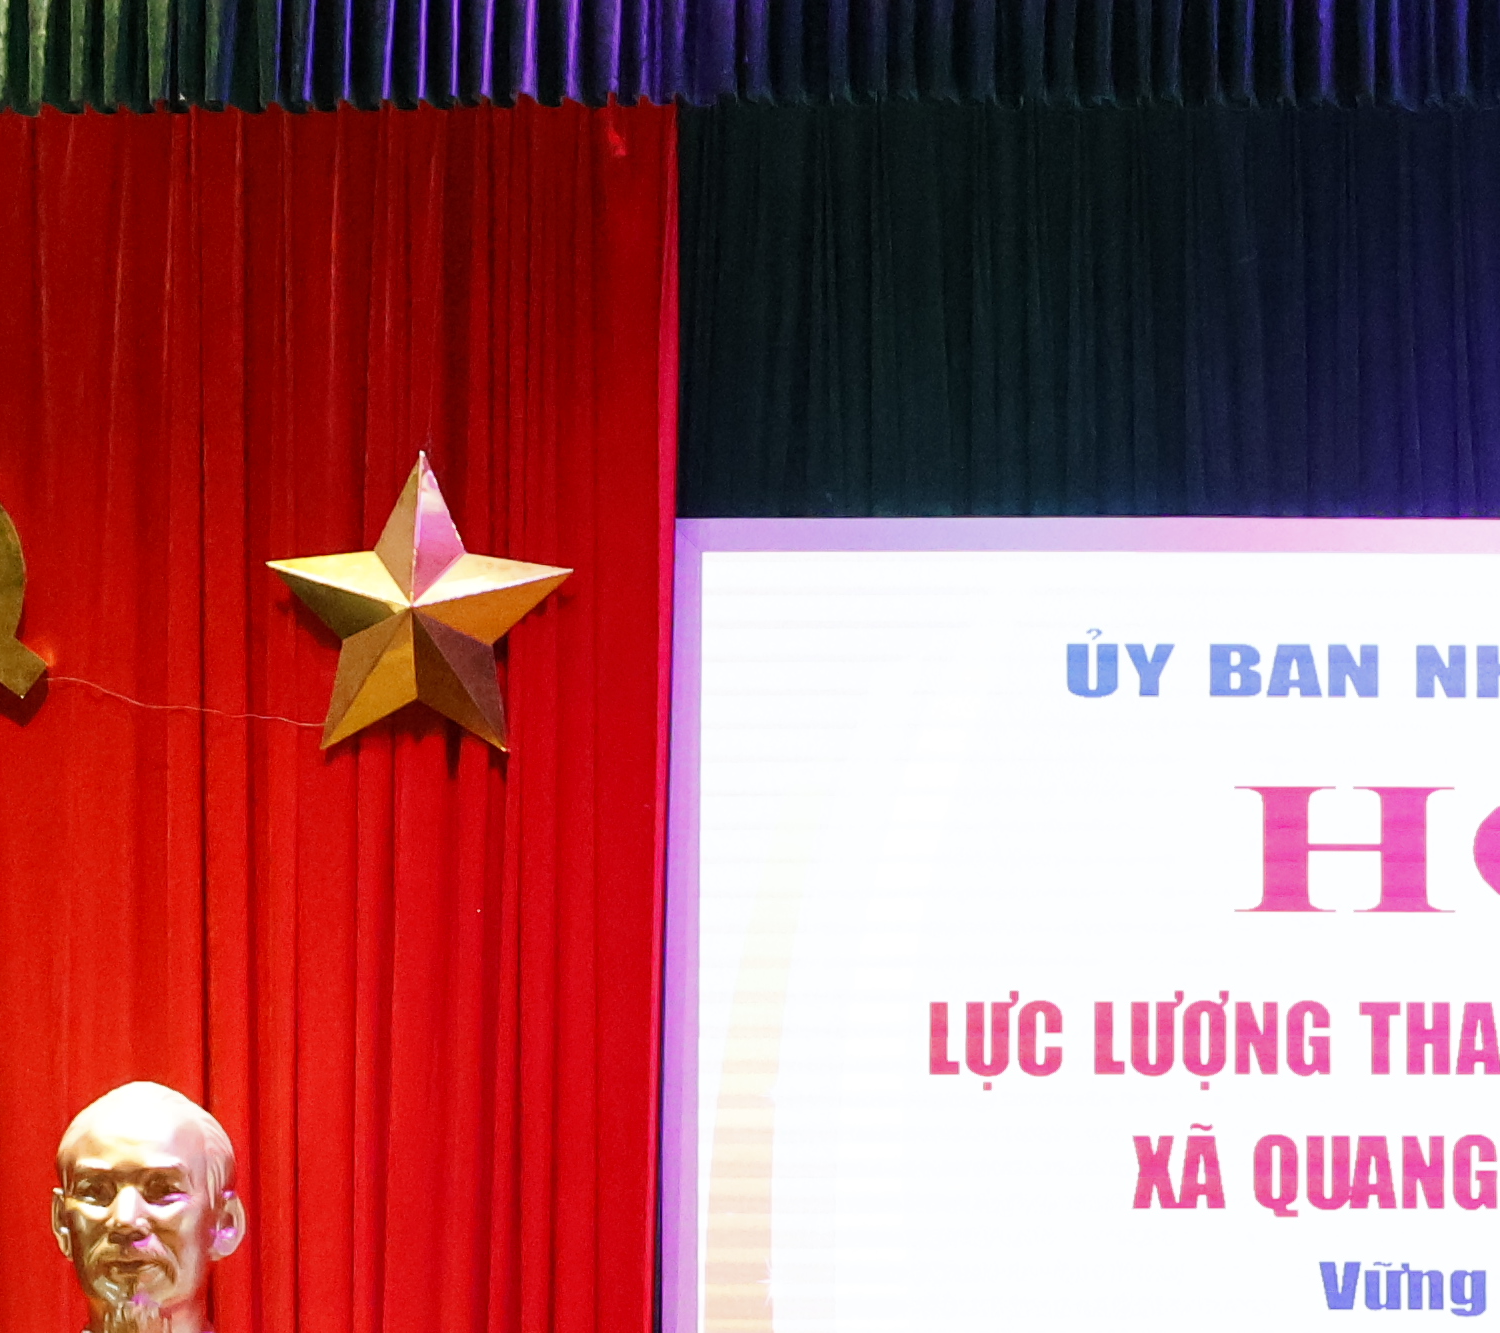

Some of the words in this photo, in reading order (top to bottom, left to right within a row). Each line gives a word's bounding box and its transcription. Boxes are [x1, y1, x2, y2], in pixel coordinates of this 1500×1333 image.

[1066, 628, 1175, 698] ỦY
[1209, 642, 1380, 698] BAN
[929, 990, 1063, 1091] LỰC
[1094, 990, 1331, 1091] LƯỢNG
[1132, 1123, 1227, 1210] XÃ
[1253, 1134, 1499, 1218] QUANG
[1319, 1261, 1488, 1318] Vững
